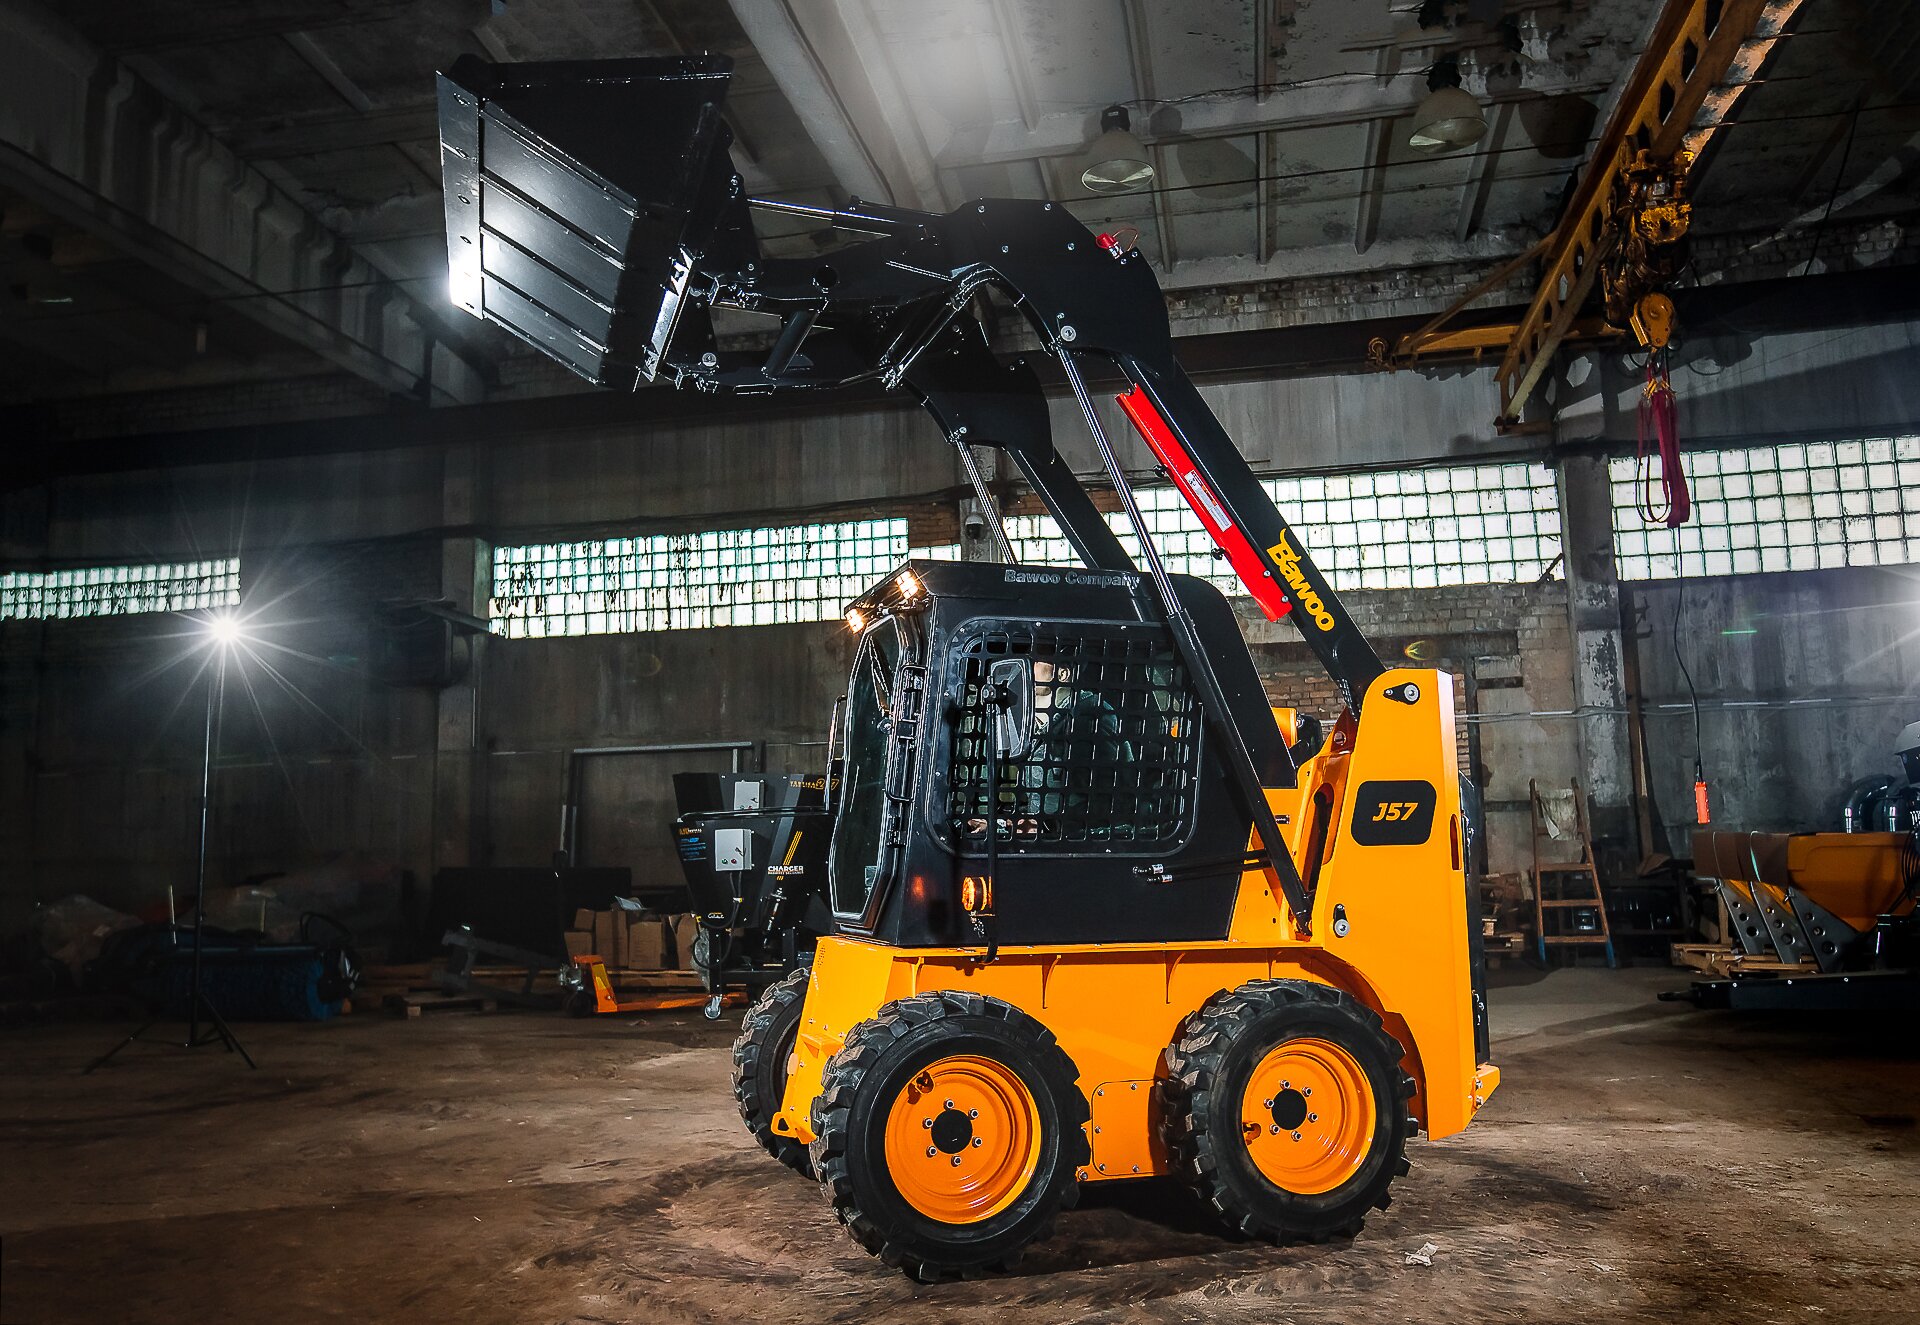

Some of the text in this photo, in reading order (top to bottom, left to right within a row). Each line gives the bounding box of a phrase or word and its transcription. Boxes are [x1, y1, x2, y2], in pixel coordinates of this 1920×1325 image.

[1004, 569, 1141, 590] Bawoo Company
[1266, 528, 1335, 632] Bawoo
[1372, 802, 1419, 822] J57
